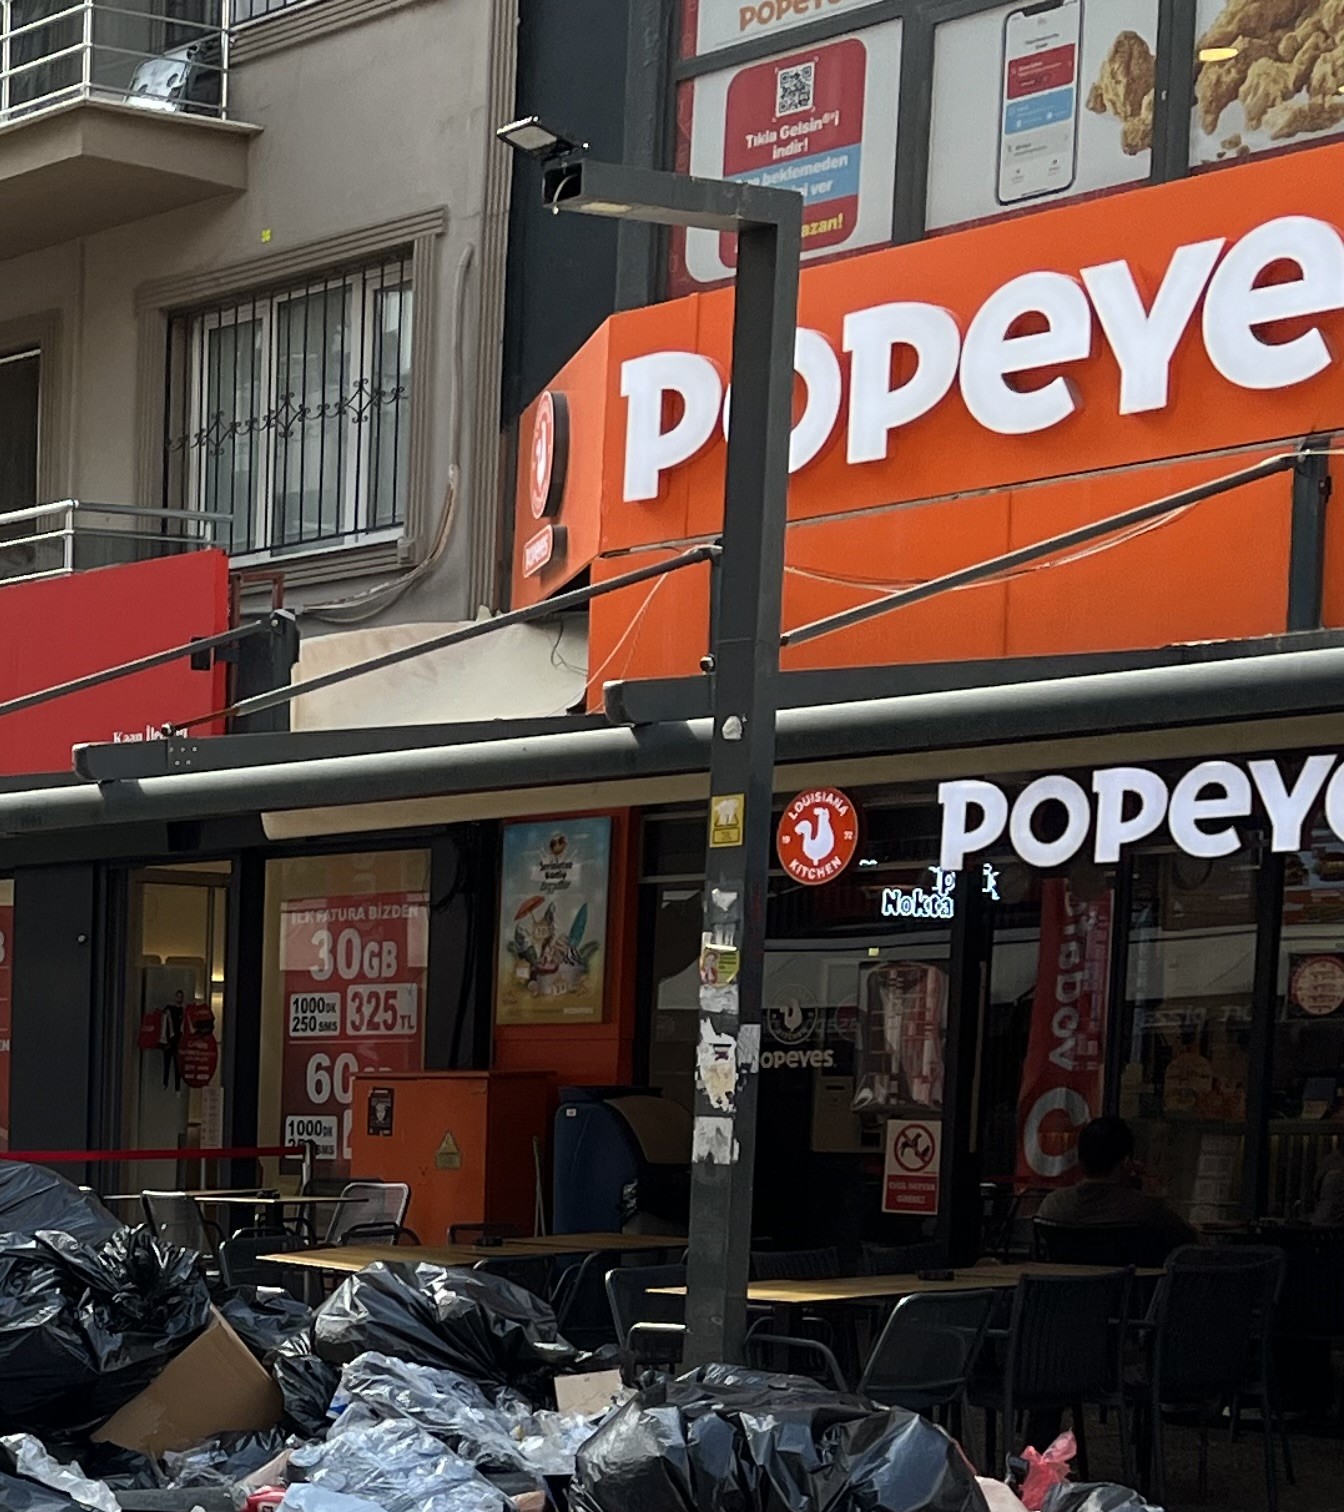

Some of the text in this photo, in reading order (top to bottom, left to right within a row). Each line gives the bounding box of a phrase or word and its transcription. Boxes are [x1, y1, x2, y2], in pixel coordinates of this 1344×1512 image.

[788, 791, 850, 820] LOUISIANA
[788, 855, 843, 880] KITCHEN
[368, 903, 419, 920] BİZDEN
